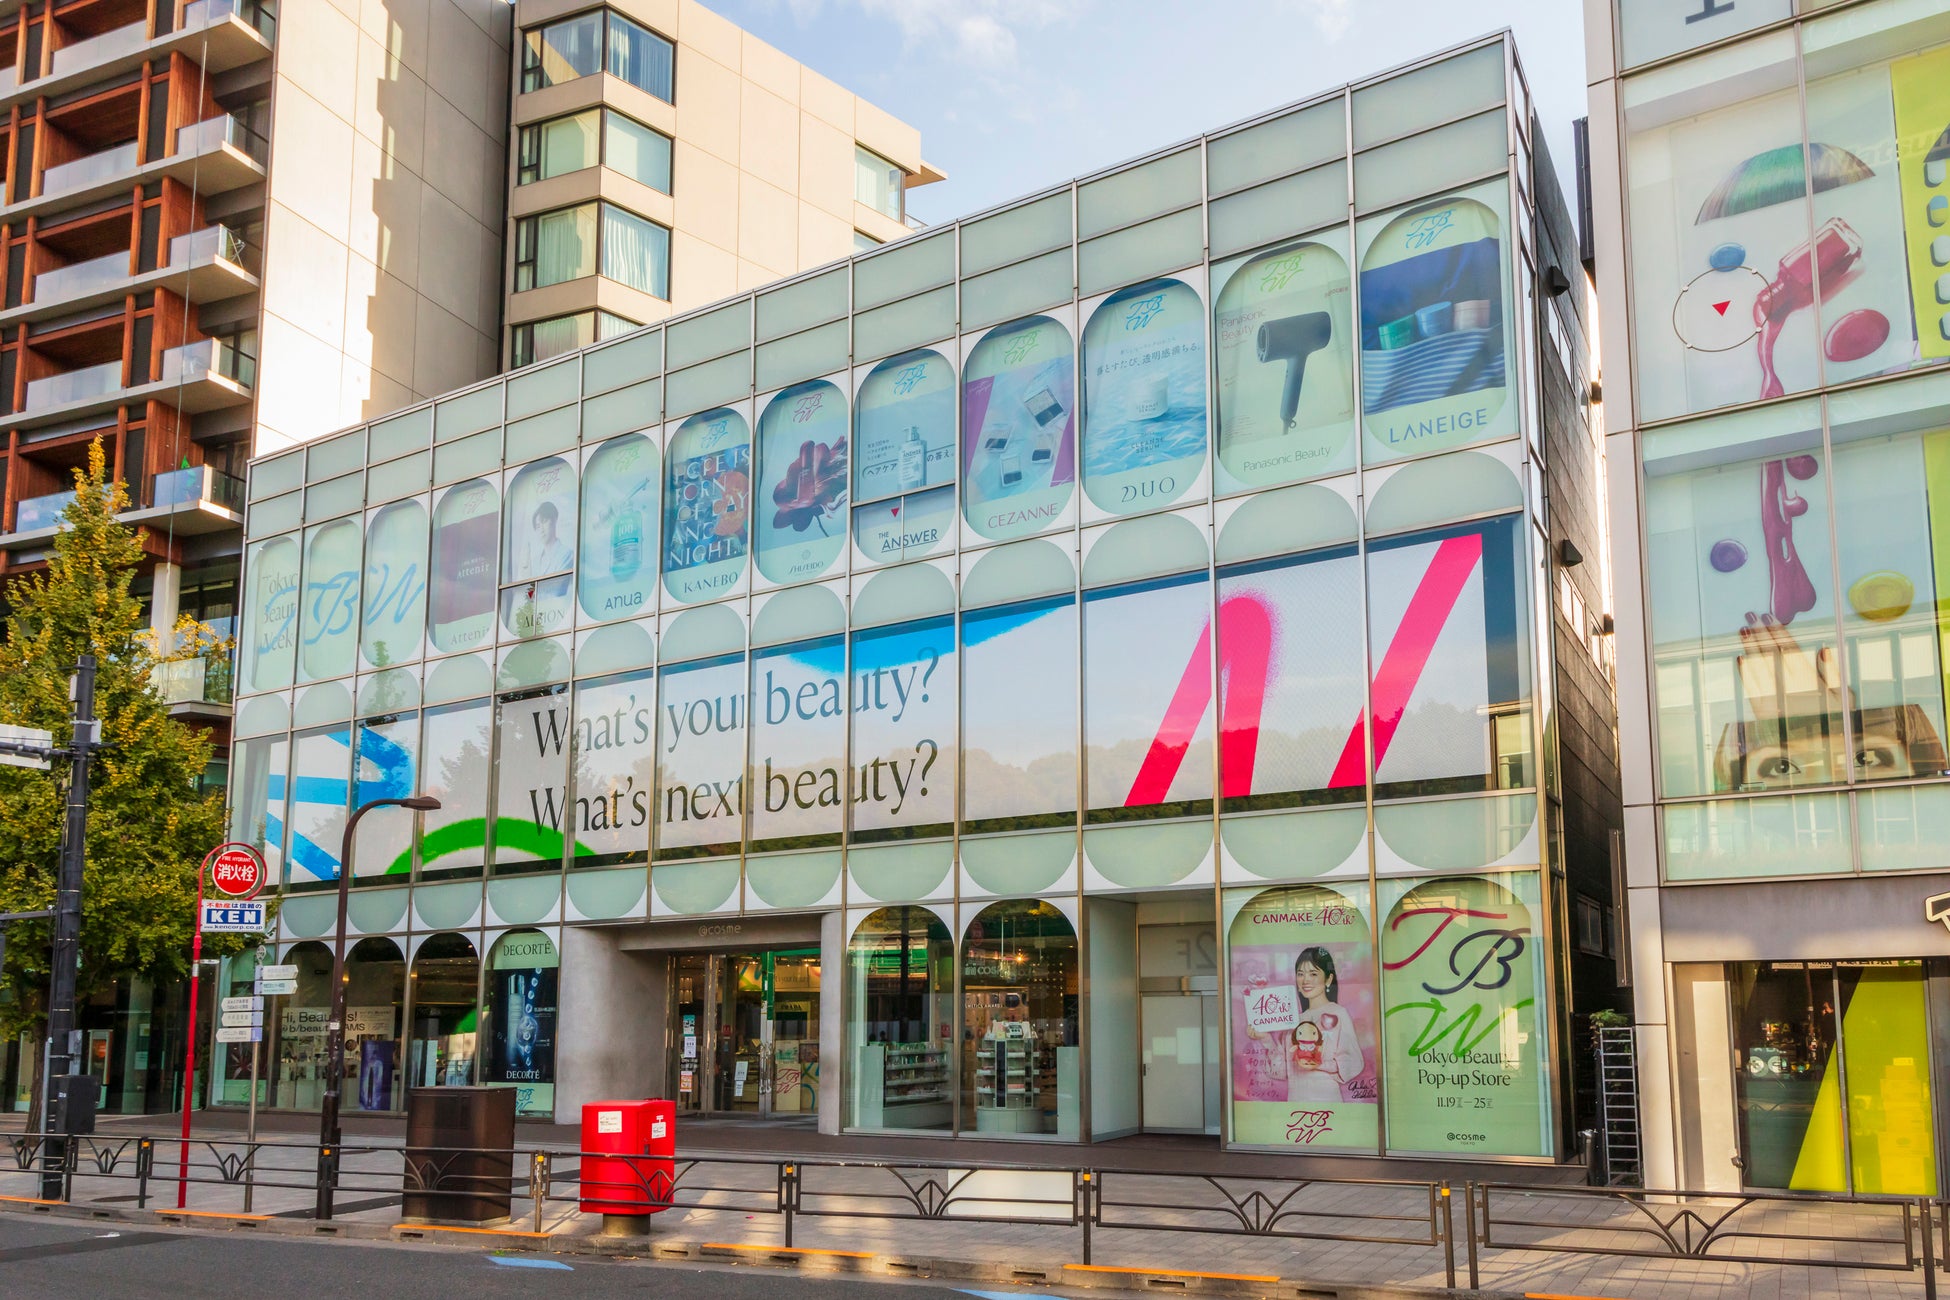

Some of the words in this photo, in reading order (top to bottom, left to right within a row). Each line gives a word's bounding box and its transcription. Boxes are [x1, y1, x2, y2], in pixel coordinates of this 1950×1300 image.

[1389, 408, 1488, 443] LANEIGE
[1243, 455, 1292, 472] Panasonic
[1295, 446, 1332, 462] Beauty
[1121, 476, 1175, 503] DUO
[988, 502, 1059, 529] CEZANNE
[878, 531, 889, 539] THE
[881, 528, 938, 551] ANSWER
[684, 572, 739, 593] KANEBO
[605, 591, 643, 611] Anua
[533, 694, 649, 758] What's
[766, 646, 939, 726] beauty?
[529, 775, 646, 837] What's
[665, 774, 744, 823] next
[764, 738, 938, 816] beauty?
[217, 863, 255, 882] 消火栓
[210, 909, 257, 923] KEN
[1253, 912, 1313, 924] CANMAKE
[698, 924, 742, 937] @cosme
[503, 941, 552, 957] DECORTÉ
[1254, 1014, 1293, 1026] CANMAKE
[1416, 1048, 1459, 1067] Tokyo
[506, 1070, 540, 1080] DECORTÉ
[1418, 1069, 1470, 1090] Pop-up
[1472, 1069, 1511, 1087] Store
[1446, 1132, 1486, 1142] @cosme
